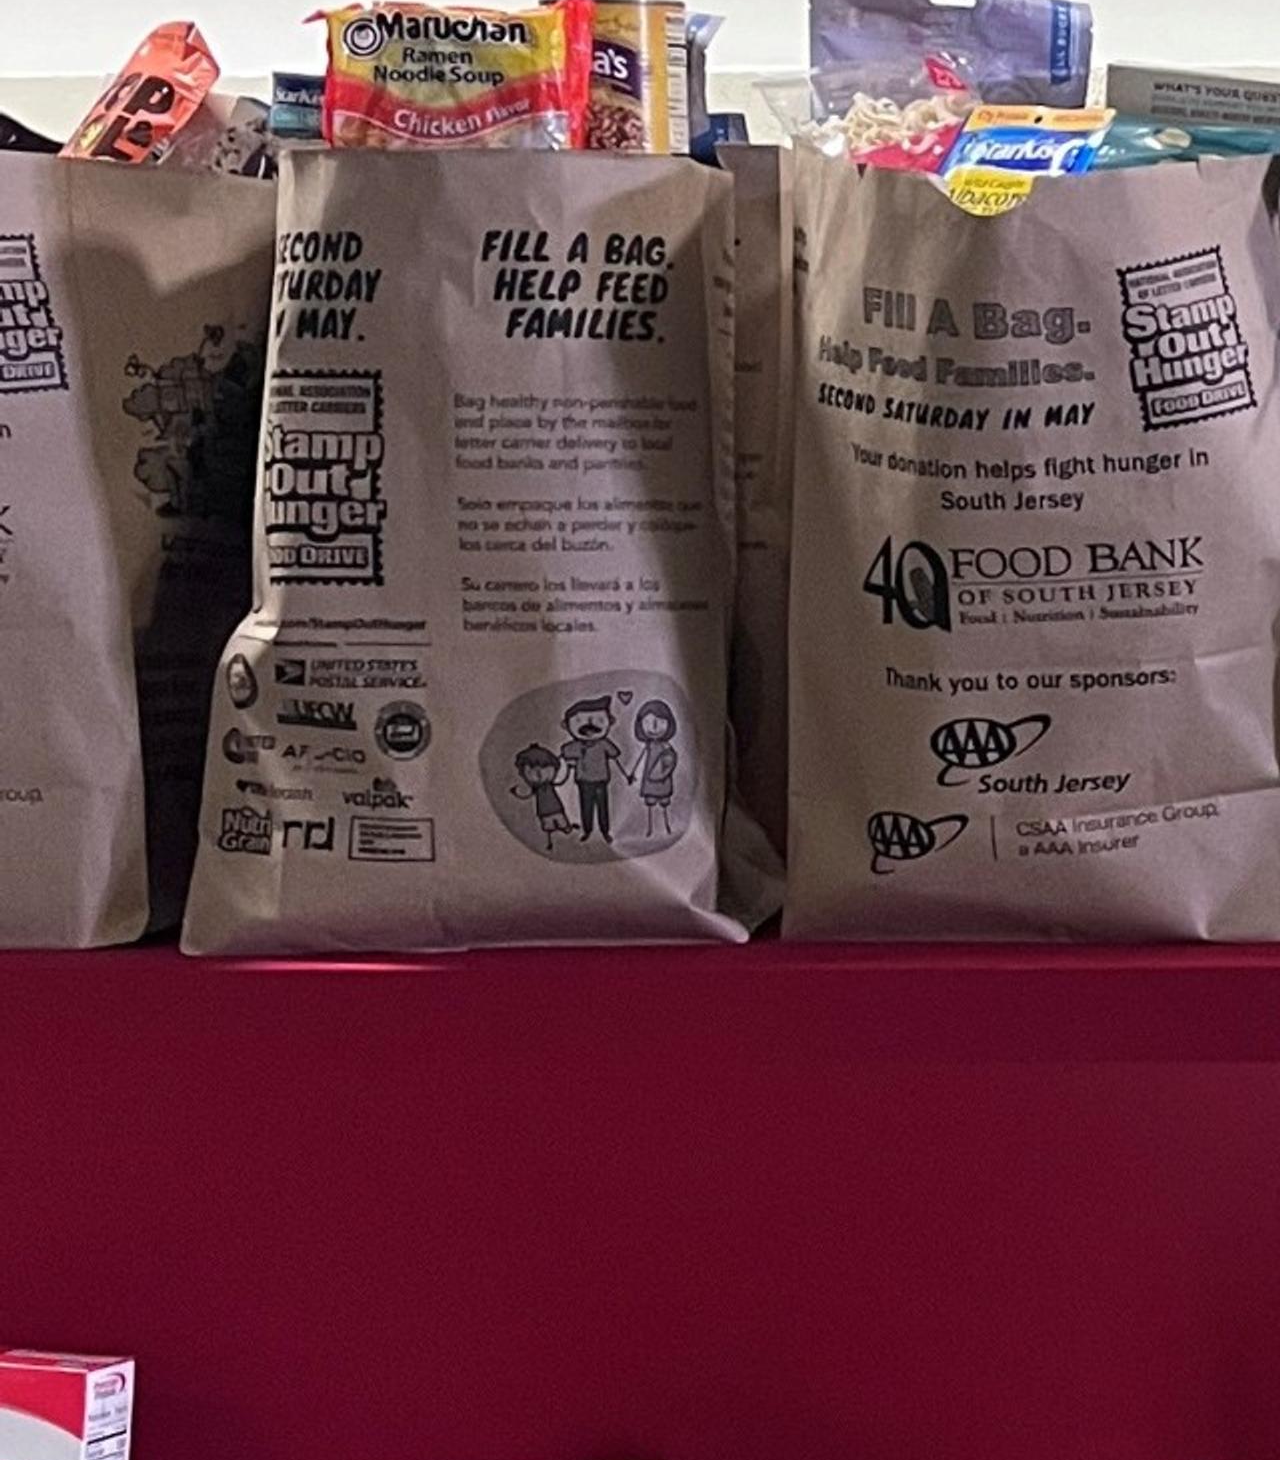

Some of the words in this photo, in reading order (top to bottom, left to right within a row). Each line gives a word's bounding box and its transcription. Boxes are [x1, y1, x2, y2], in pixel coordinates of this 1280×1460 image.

[377, 11, 528, 44] Maruchan
[402, 47, 473, 65] Ramen
[374, 66, 445, 83] Noodle
[450, 67, 505, 87] Soup
[394, 109, 481, 138] Chicken
[481, 230, 552, 263] FILL
[566, 231, 589, 262] A
[604, 235, 675, 269] BAG.
[494, 268, 581, 303] HELP
[597, 270, 669, 304] FEED
[505, 308, 665, 341] FAMILIES.
[819, 384, 876, 415] SECOND
[883, 398, 989, 431] SATURDAY
[1003, 407, 1031, 431] IN
[1045, 402, 1095, 428] MAY
[852, 442, 883, 471] Your
[887, 451, 967, 479] donation
[975, 456, 1037, 481] helps
[1044, 454, 1096, 478] fight
[1102, 451, 1183, 474] hunger
[1189, 447, 1209, 468] in
[941, 490, 1006, 512] South
[1013, 490, 1084, 513] Jersey
